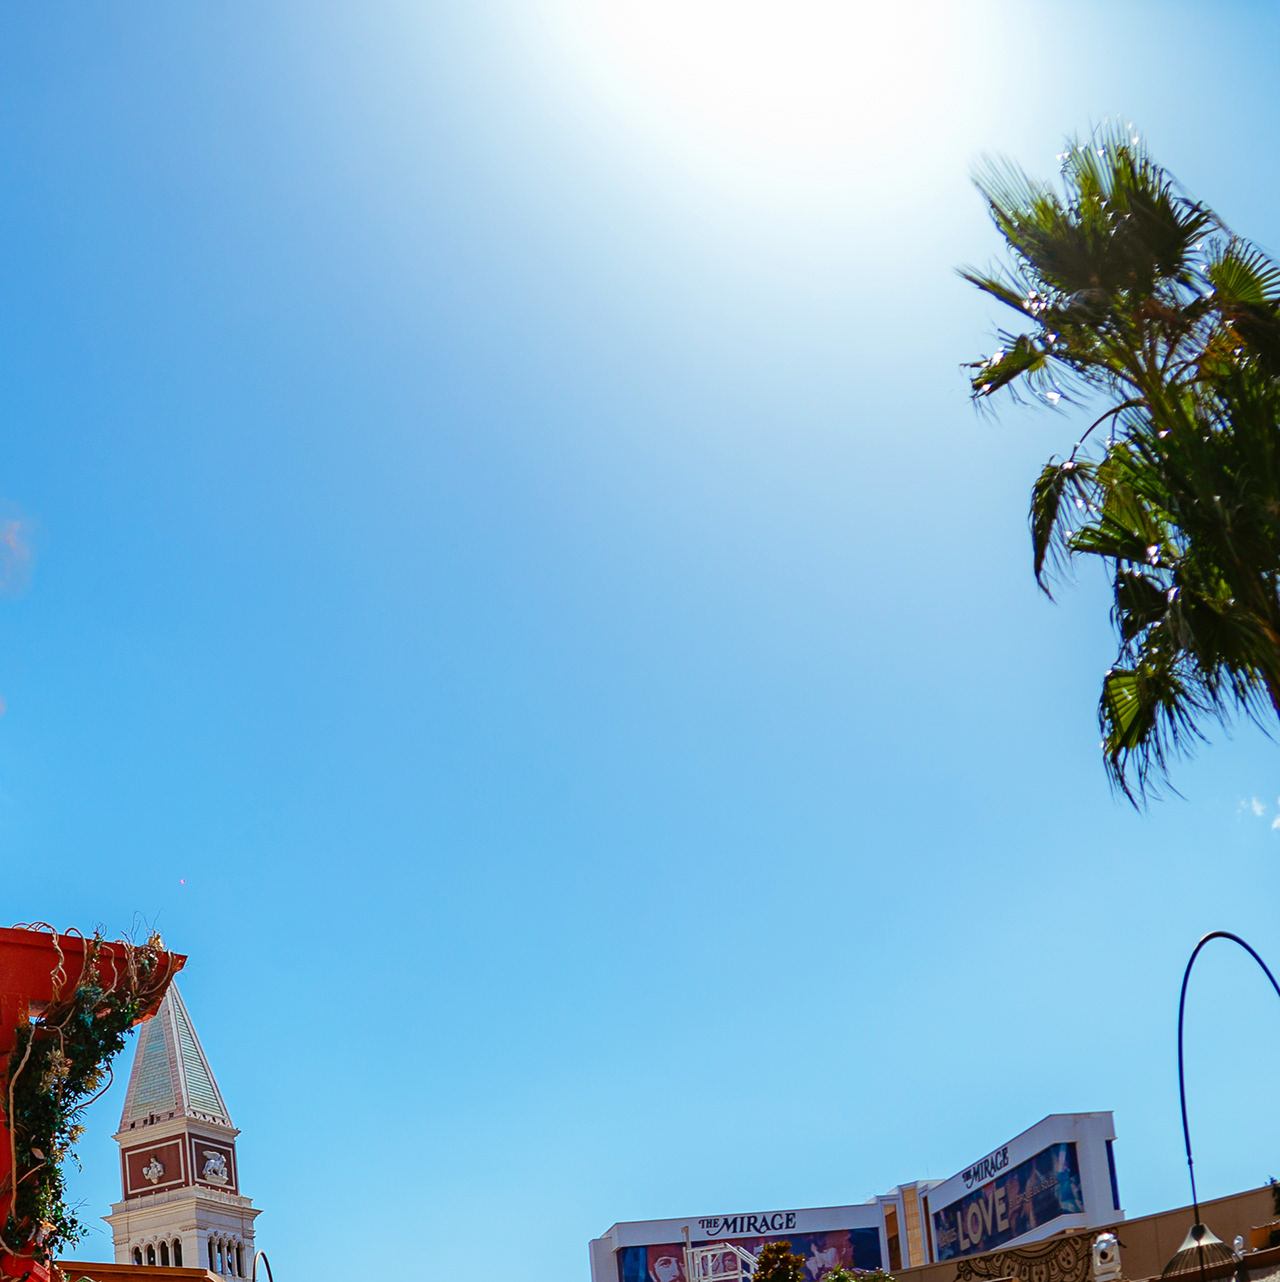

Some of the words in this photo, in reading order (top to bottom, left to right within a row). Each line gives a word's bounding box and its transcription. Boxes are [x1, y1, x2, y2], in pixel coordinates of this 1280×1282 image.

[966, 1146, 1009, 1189] MIRAGE
[698, 1218, 719, 1229] THE
[706, 1212, 796, 1236] MIRAGE
[956, 1187, 1010, 1251] LOVE
